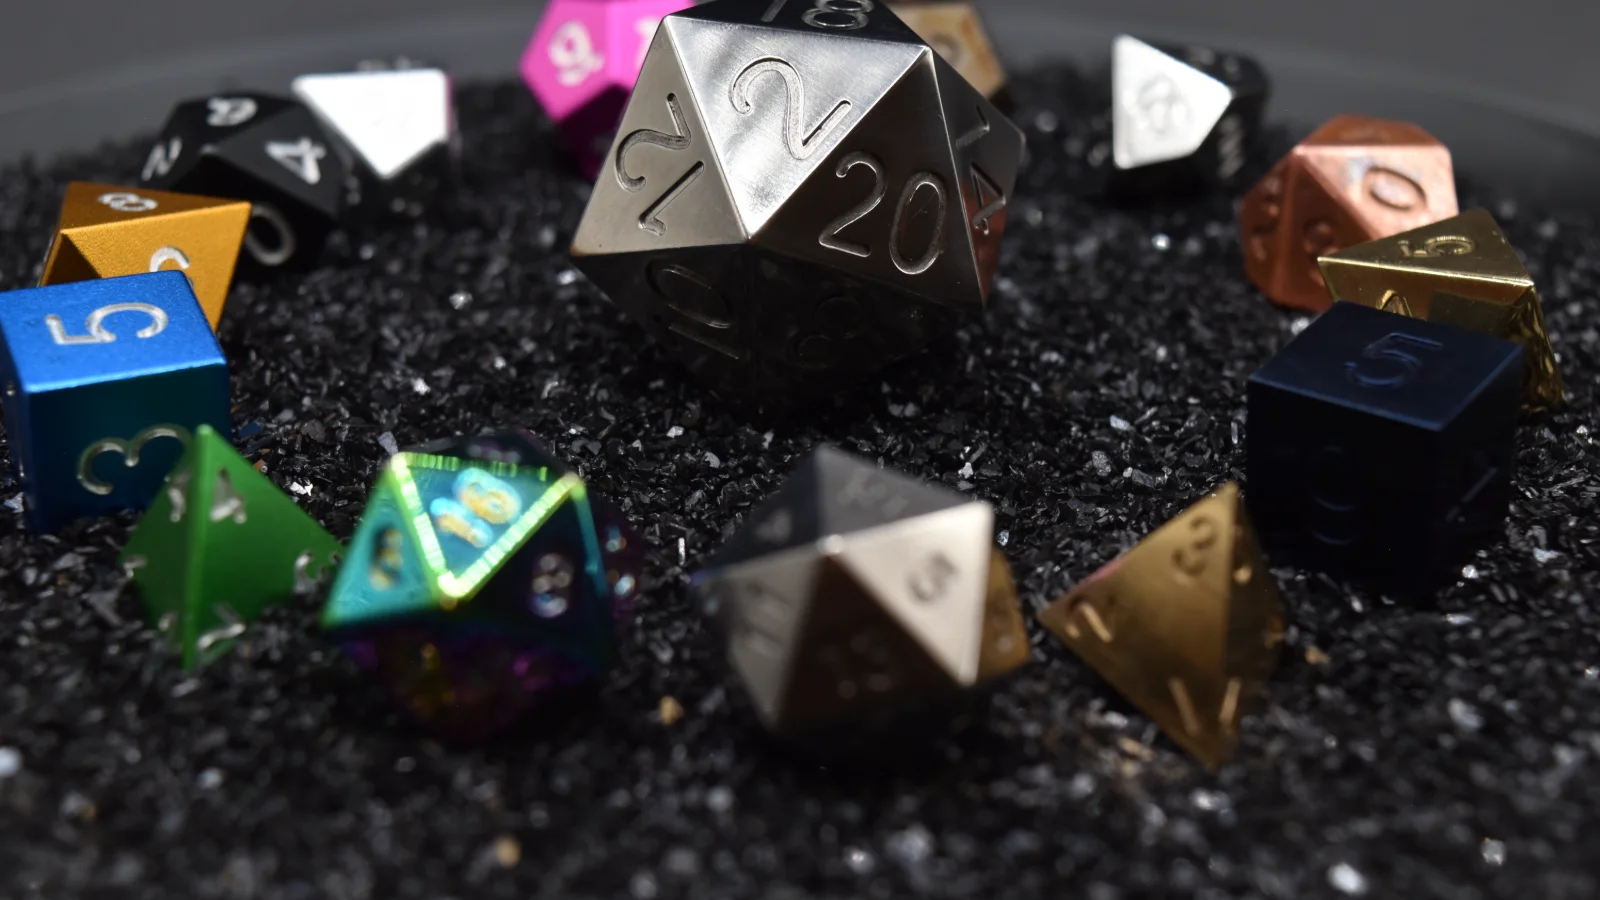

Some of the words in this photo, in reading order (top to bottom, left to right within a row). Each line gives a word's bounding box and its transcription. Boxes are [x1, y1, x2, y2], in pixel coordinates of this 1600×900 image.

[729, 57, 852, 160] 2
[265, 137, 327, 185] 4
[615, 93, 704, 236] 12
[956, 105, 1006, 235] 14
[1365, 165, 1426, 211] 0
[97, 192, 158, 212] 8
[248, 203, 295, 265] 0
[818, 151, 947, 276] 20
[45, 302, 169, 345] 5
[646, 258, 742, 360] 10
[1344, 331, 1444, 388] 5
[76, 423, 193, 495] 3
[430, 467, 522, 549] 16
